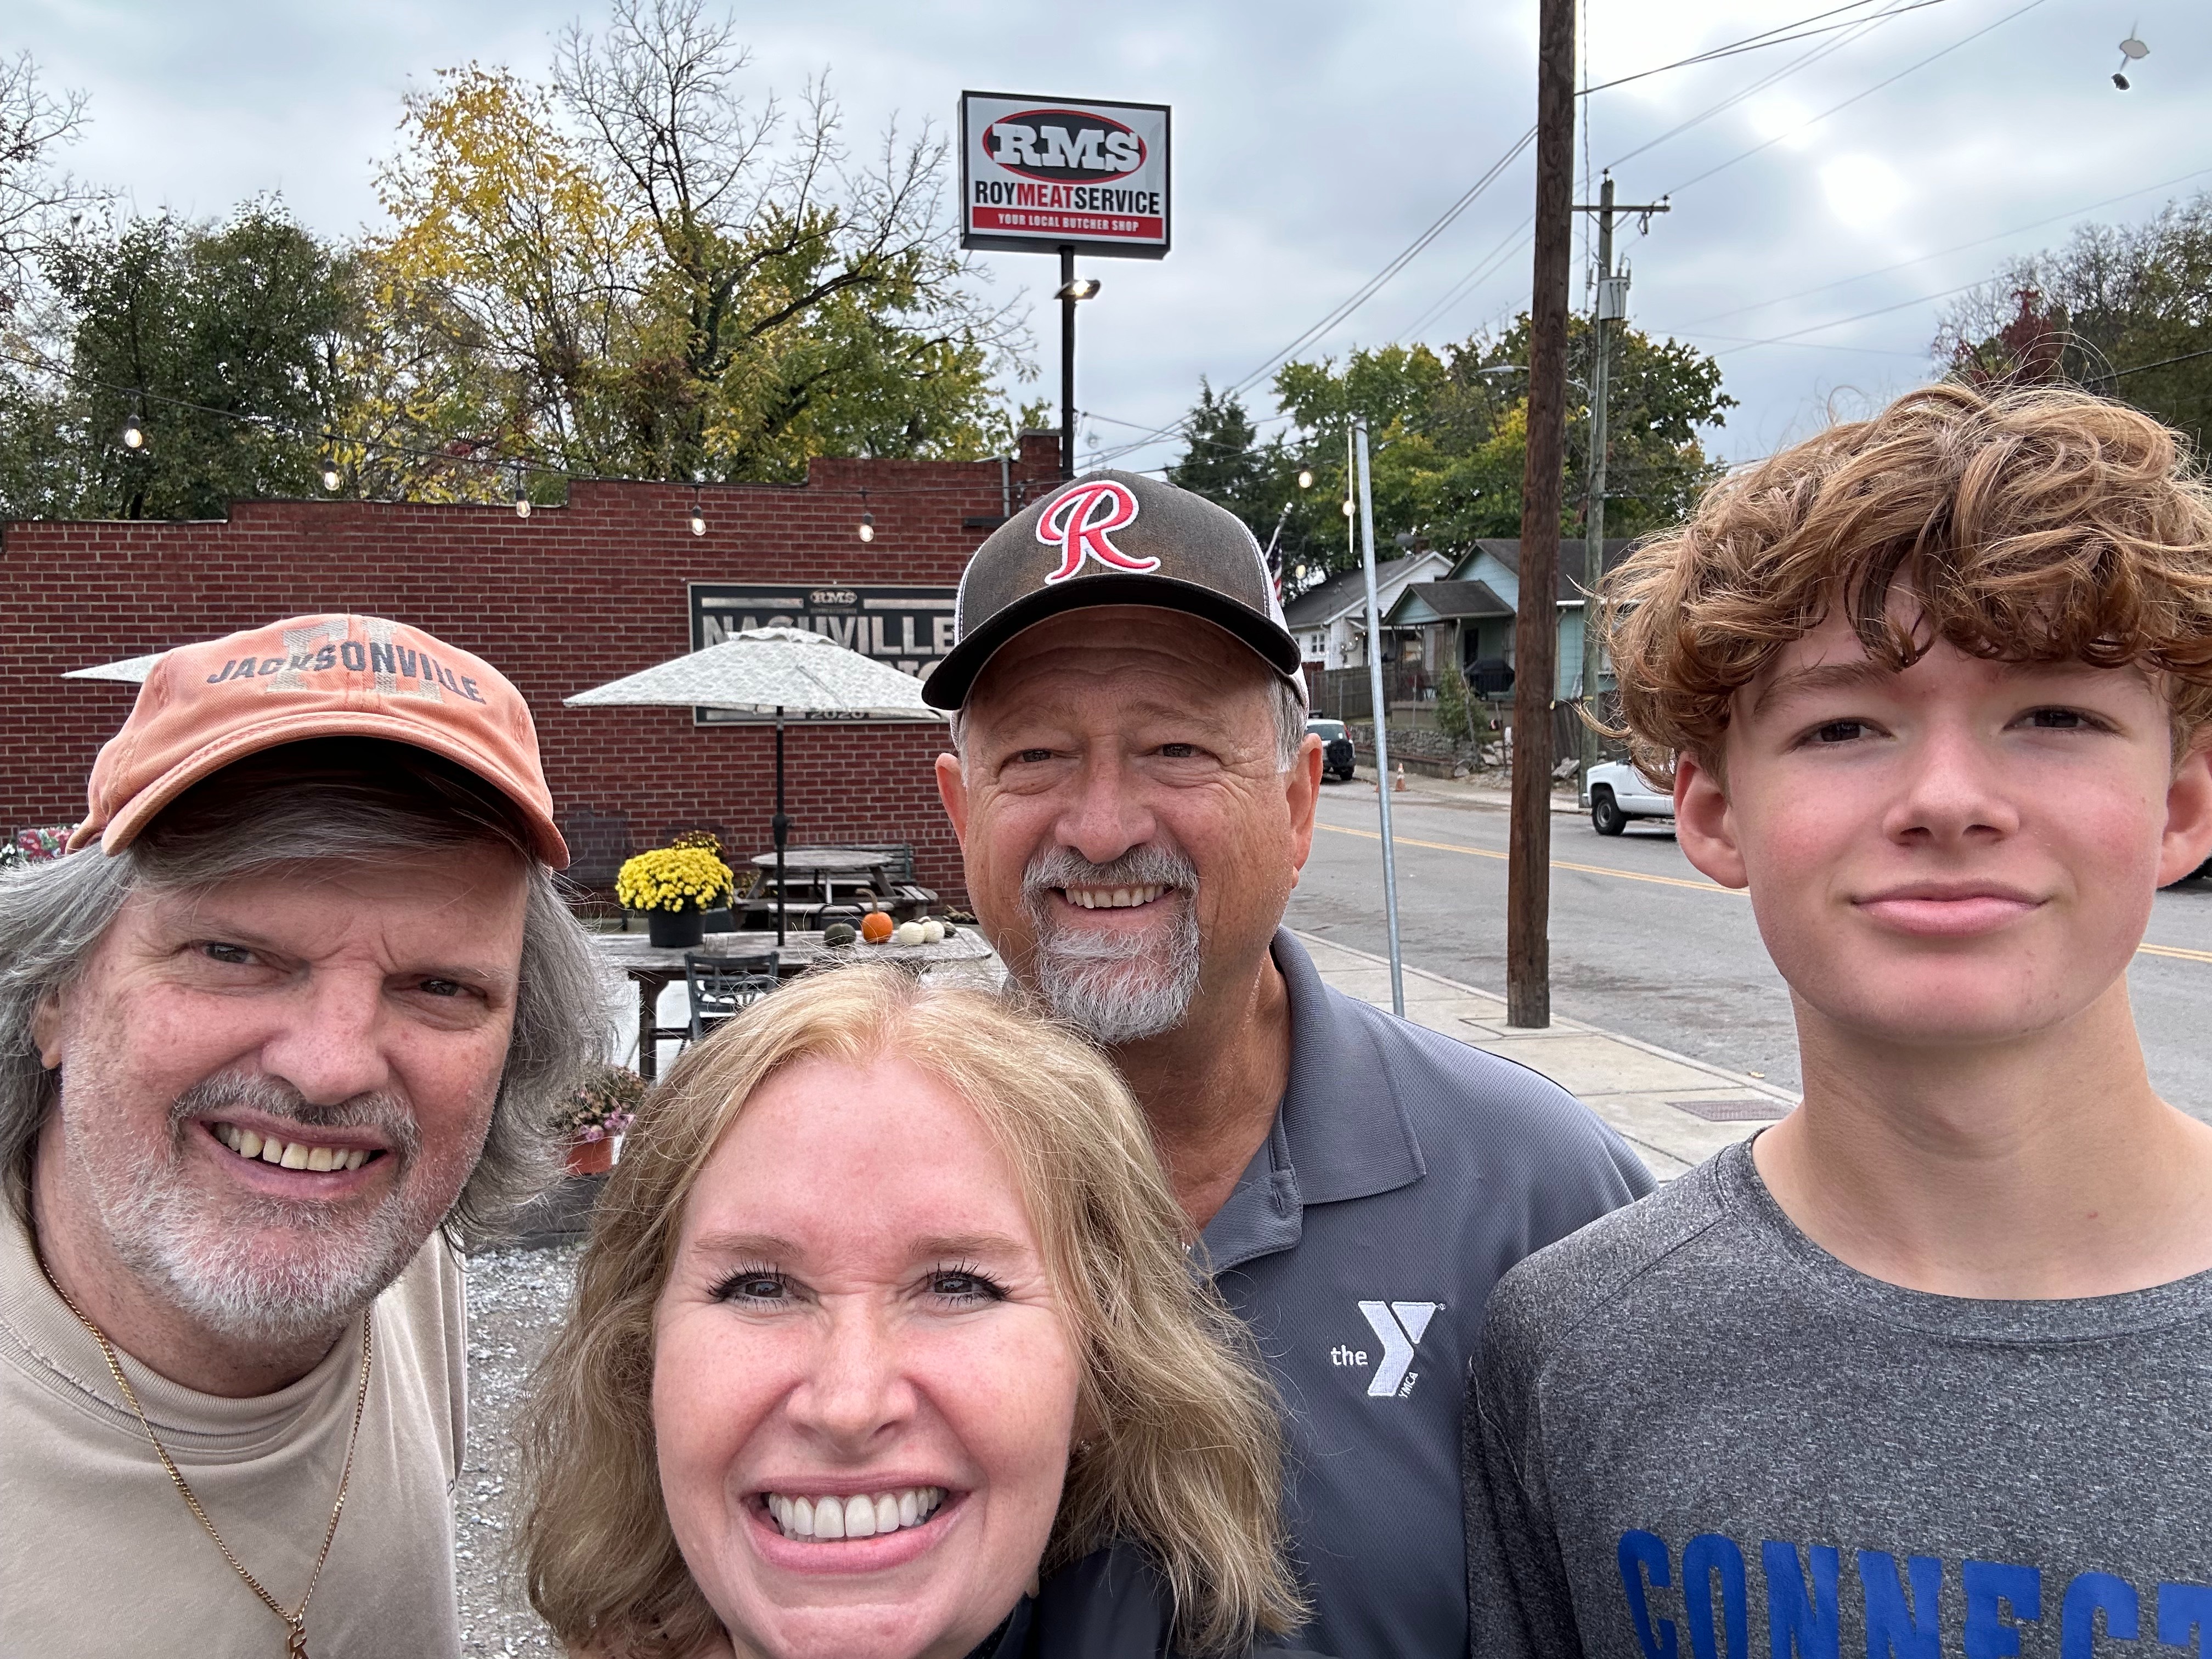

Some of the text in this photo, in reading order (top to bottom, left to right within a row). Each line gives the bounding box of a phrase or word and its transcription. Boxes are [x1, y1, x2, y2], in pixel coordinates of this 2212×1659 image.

[992, 122, 1142, 173] RMS
[997, 213, 1139, 232] YOUR LOCAL BUTCHER SHOP
[1036, 480, 1161, 585] R
[812, 591, 857, 603] RMS
[206, 641, 487, 706] JACKSONVILLE
[1330, 1300, 1436, 1397] the Y
[1398, 1372, 1419, 1398] YMCA
